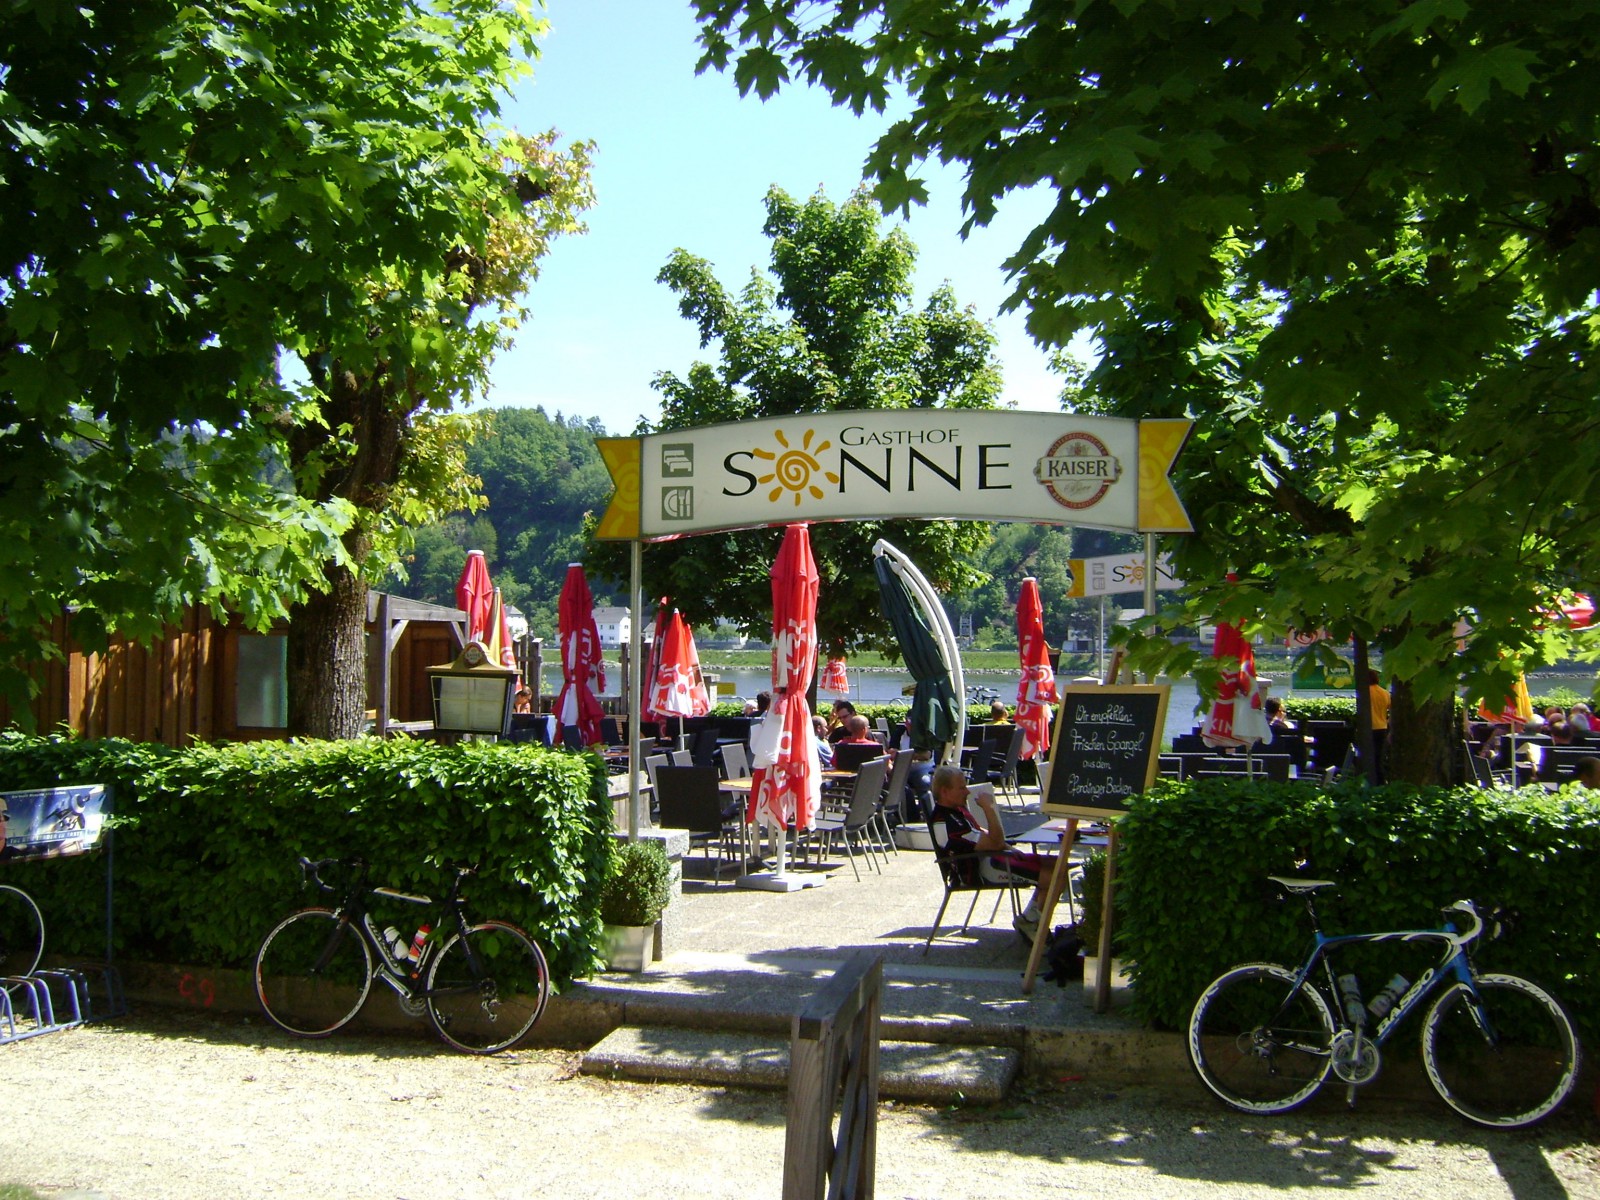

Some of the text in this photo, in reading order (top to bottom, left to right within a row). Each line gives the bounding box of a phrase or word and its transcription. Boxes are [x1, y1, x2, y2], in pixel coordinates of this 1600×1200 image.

[839, 426, 960, 447] GASTHOF
[1048, 460, 1108, 478] KAISER
[1075, 704, 1089, 721] Wir
[1070, 728, 1145, 759] Frischen Spargel
[1083, 756, 1112, 769] aus dem
[1376, 967, 1435, 1037] BASSO
